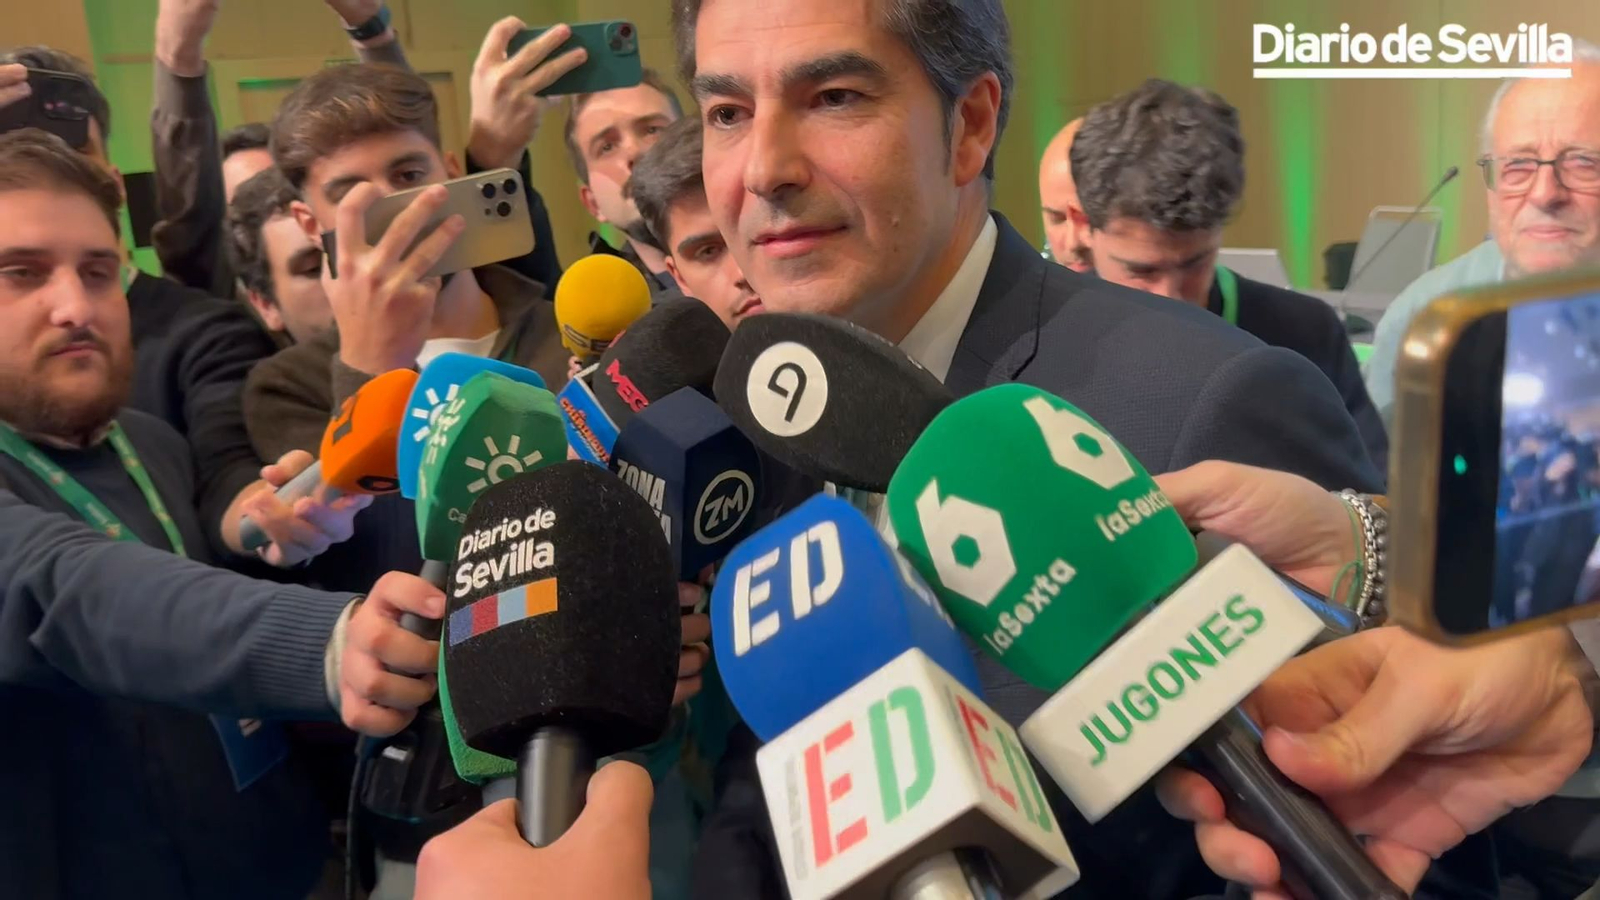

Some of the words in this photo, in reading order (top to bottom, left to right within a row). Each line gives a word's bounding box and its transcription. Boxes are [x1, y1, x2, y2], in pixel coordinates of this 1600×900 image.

[458, 517, 522, 561] Diario
[524, 507, 556, 534] de
[617, 458, 666, 511] ZONA
[705, 483, 744, 531] ZM
[915, 476, 1017, 608] 6
[453, 537, 555, 598] Sevilla
[733, 520, 844, 657] ED
[983, 557, 1077, 655] laSexta
[1079, 594, 1266, 768] JUGONES
[804, 686, 936, 868] ED
[955, 694, 1053, 833] ED
